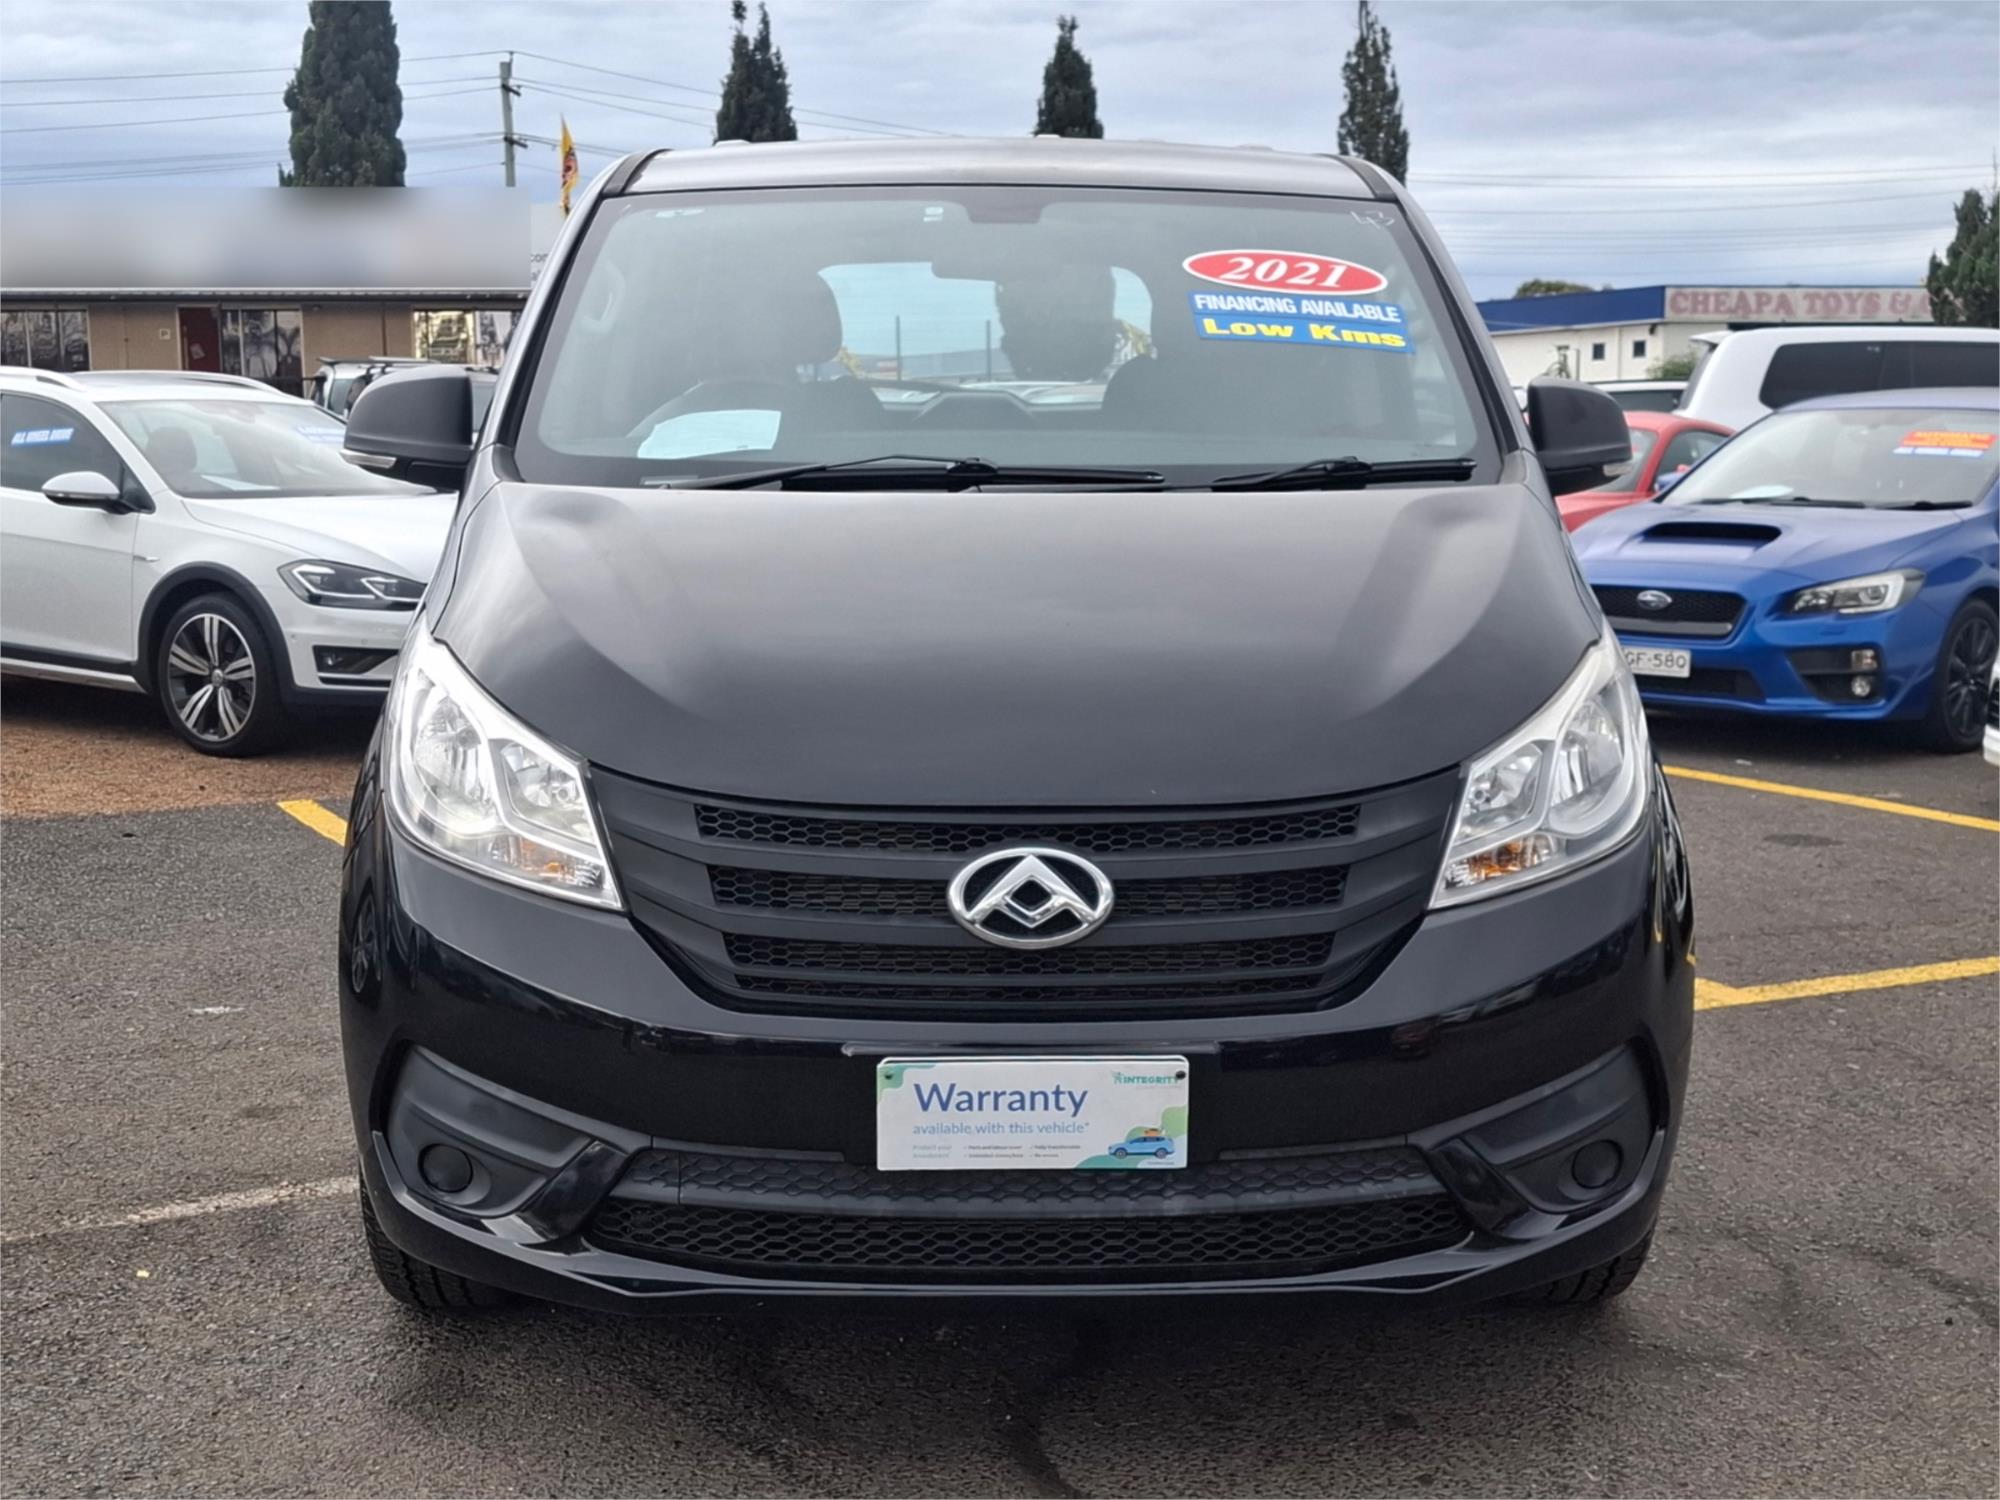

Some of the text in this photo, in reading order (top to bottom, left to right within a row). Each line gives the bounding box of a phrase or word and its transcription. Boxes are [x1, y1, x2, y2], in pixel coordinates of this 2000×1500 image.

[1219, 256, 1348, 288] 2021
[1194, 294, 1402, 323] FINANCING AVAILABLE
[1669, 290, 1794, 316] CHEAPA
[1803, 291, 1881, 316] TOYS
[913, 1083, 1089, 1118] Warranty
[912, 1122, 972, 1136] available
[975, 1122, 1005, 1135] with
[1008, 1121, 1034, 1135] this
